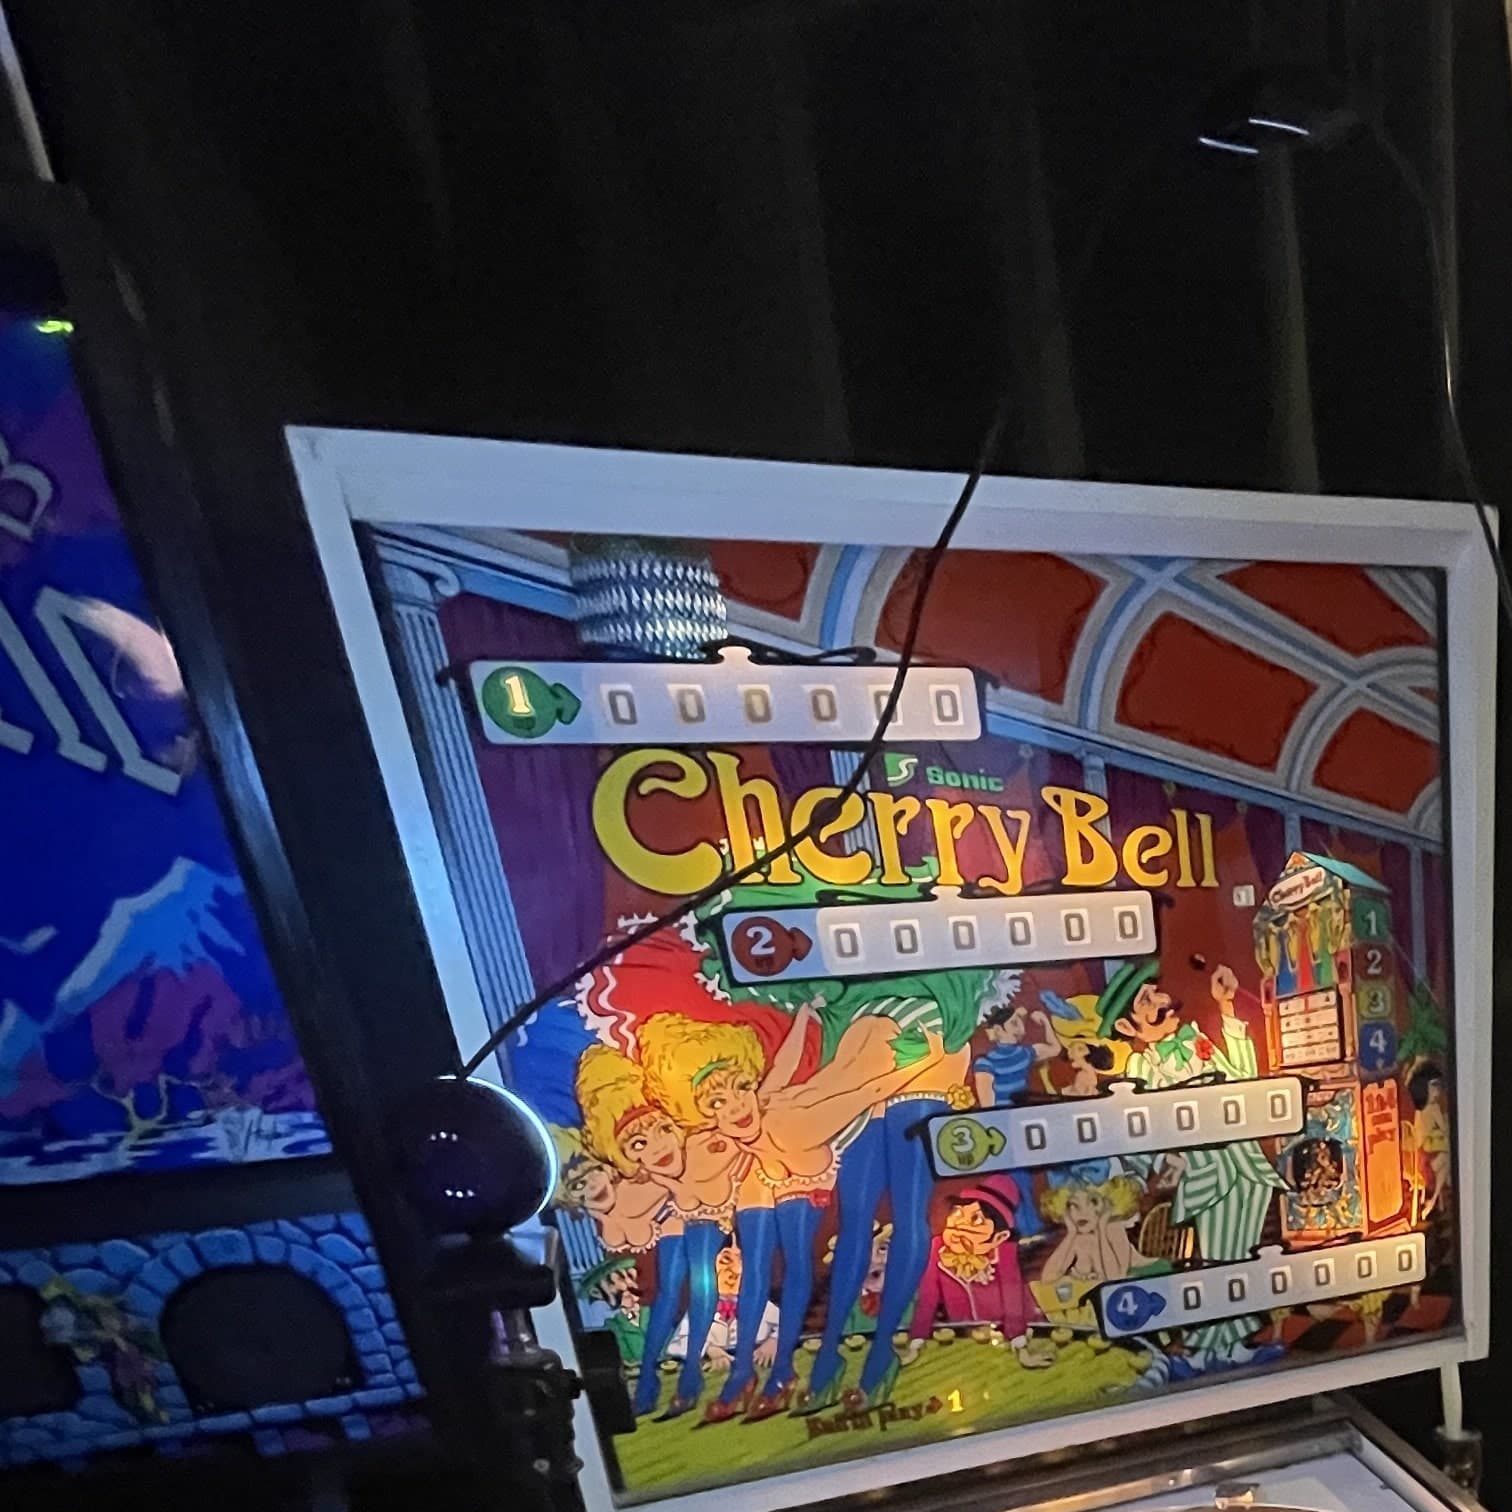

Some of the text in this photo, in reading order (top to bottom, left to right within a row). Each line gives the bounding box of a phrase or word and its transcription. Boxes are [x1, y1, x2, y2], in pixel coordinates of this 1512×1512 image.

[504, 674, 532, 714] 1
[926, 766, 1004, 793] Sonic
[592, 747, 1219, 897] Cherry Bell
[1364, 908, 1378, 936] 1
[746, 925, 777, 956] 2
[1366, 949, 1382, 975] 2
[1369, 1029, 1388, 1054] 4
[951, 1126, 976, 1153] 3
[1116, 1290, 1139, 1316] 4
